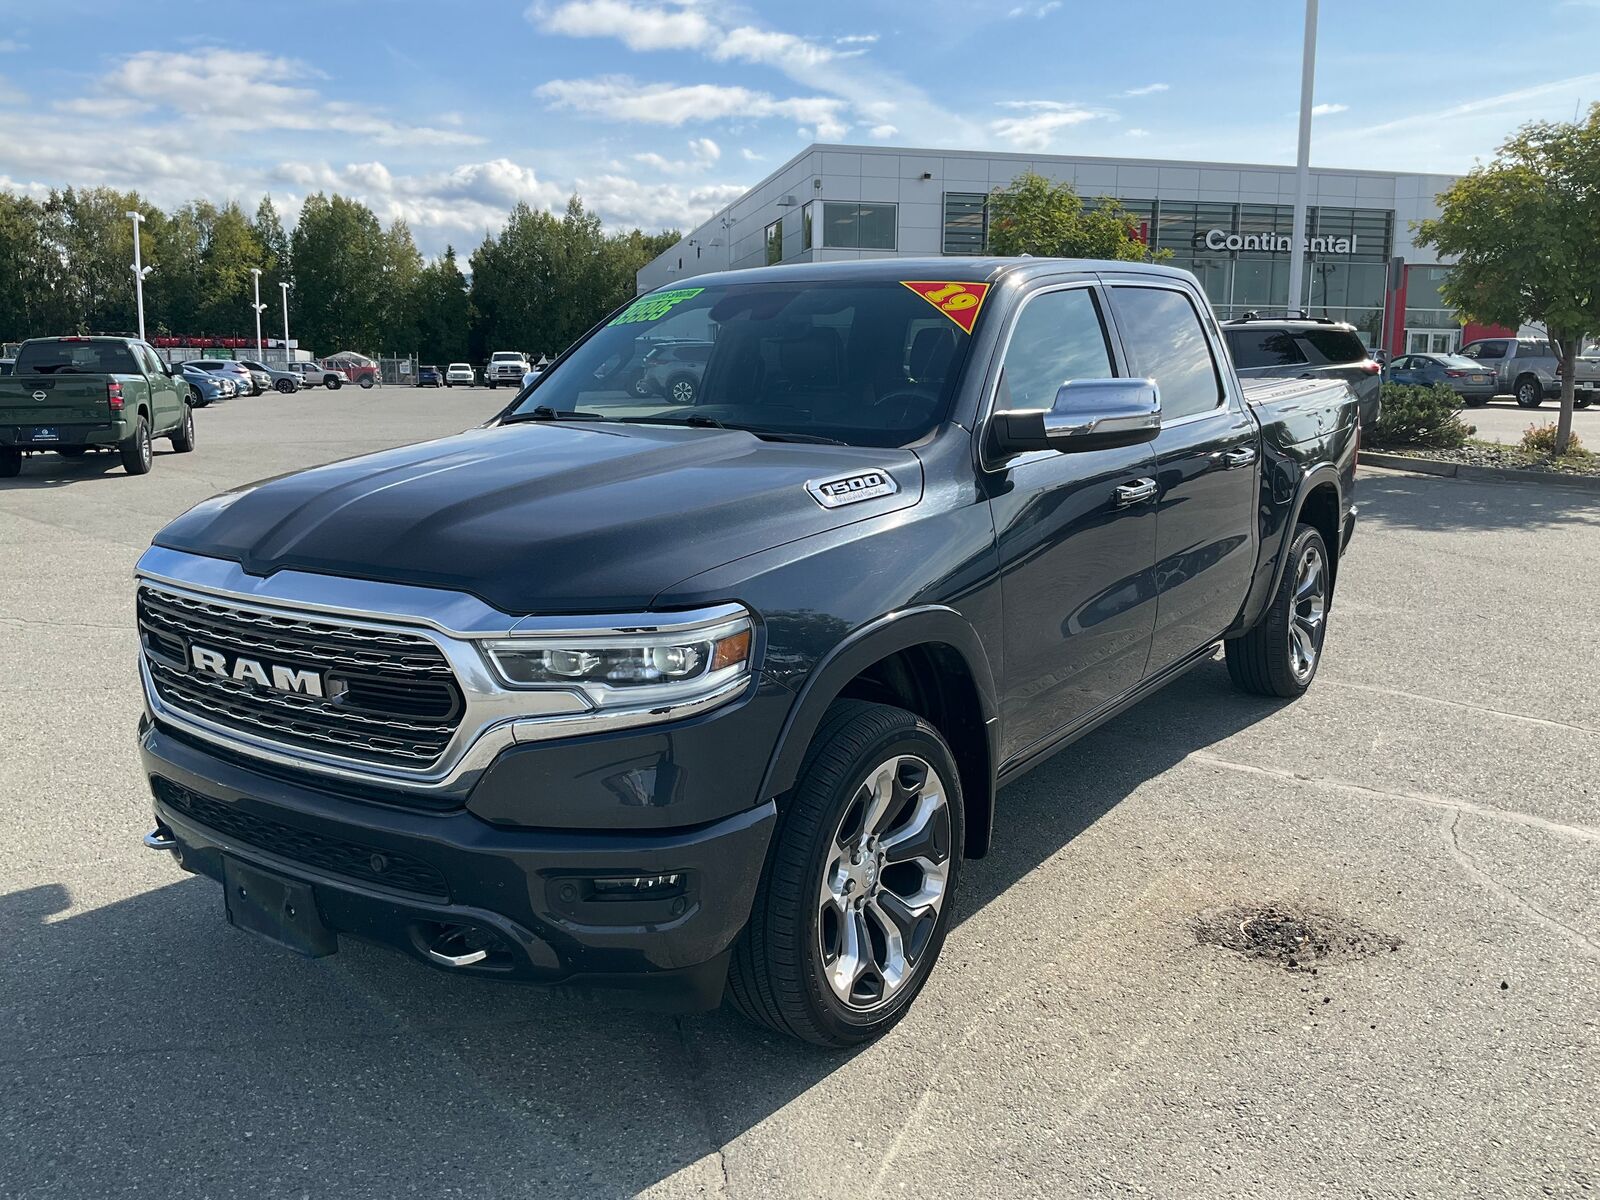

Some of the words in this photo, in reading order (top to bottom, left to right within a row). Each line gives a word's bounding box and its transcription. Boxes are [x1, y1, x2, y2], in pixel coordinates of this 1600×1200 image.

[925, 283, 979, 311] 19
[821, 474, 881, 497] 1500
[191, 645, 323, 698] RAM
